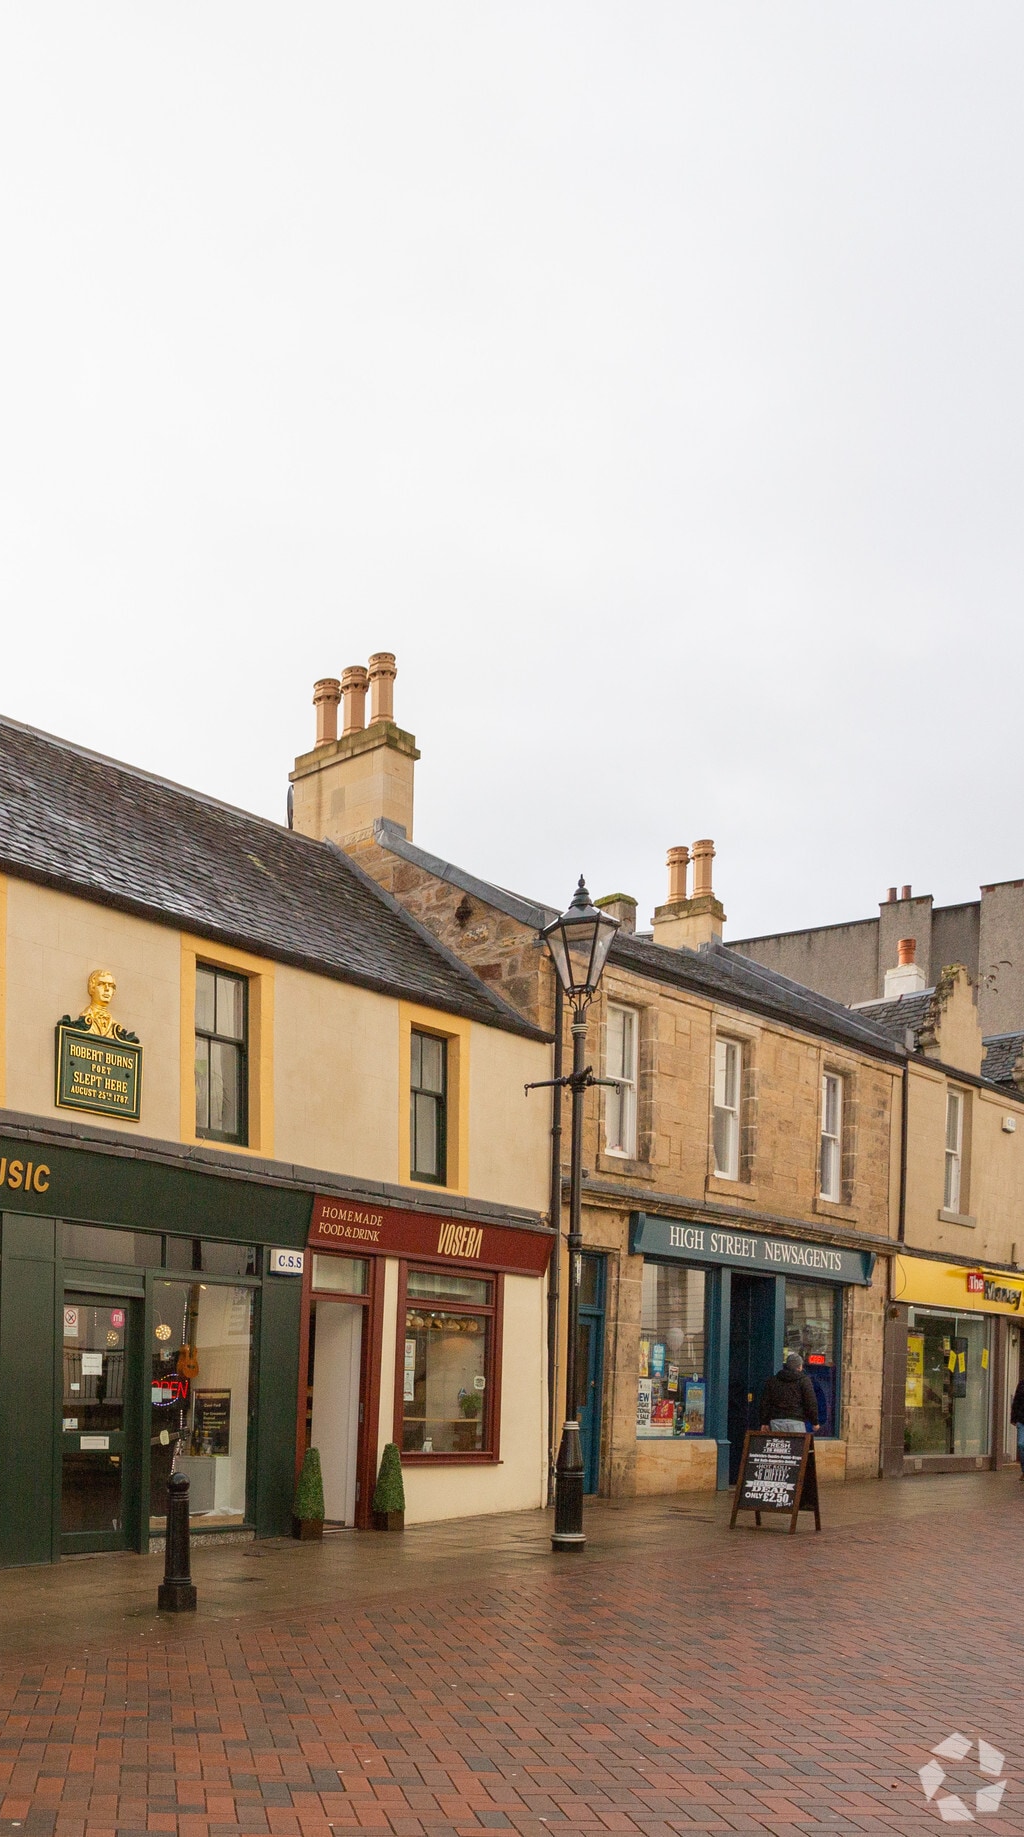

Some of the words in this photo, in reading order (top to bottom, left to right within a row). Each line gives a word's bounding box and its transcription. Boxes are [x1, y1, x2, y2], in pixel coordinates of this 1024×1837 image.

[70, 1044, 104, 1062] ROBERT
[105, 1052, 134, 1070] BURNS
[91, 1064, 112, 1075] POET
[70, 1085, 97, 1097] AUGUST
[73, 1071, 103, 1088] SLEPT
[104, 1078, 128, 1093] HERE
[321, 1206, 384, 1227] HOMEMADE
[437, 1222, 484, 1258] VOSEBA
[669, 1225, 704, 1250] HIGH
[710, 1232, 757, 1258] STREET
[764, 1241, 842, 1271] NEWSAGENTS
[969, 1275, 984, 1290] The
[984, 1280, 1022, 1311] Money
[639, 1393, 649, 1402] EW
[751, 1486, 787, 1494] DEAL
[763, 1493, 789, 1503] £2.50
